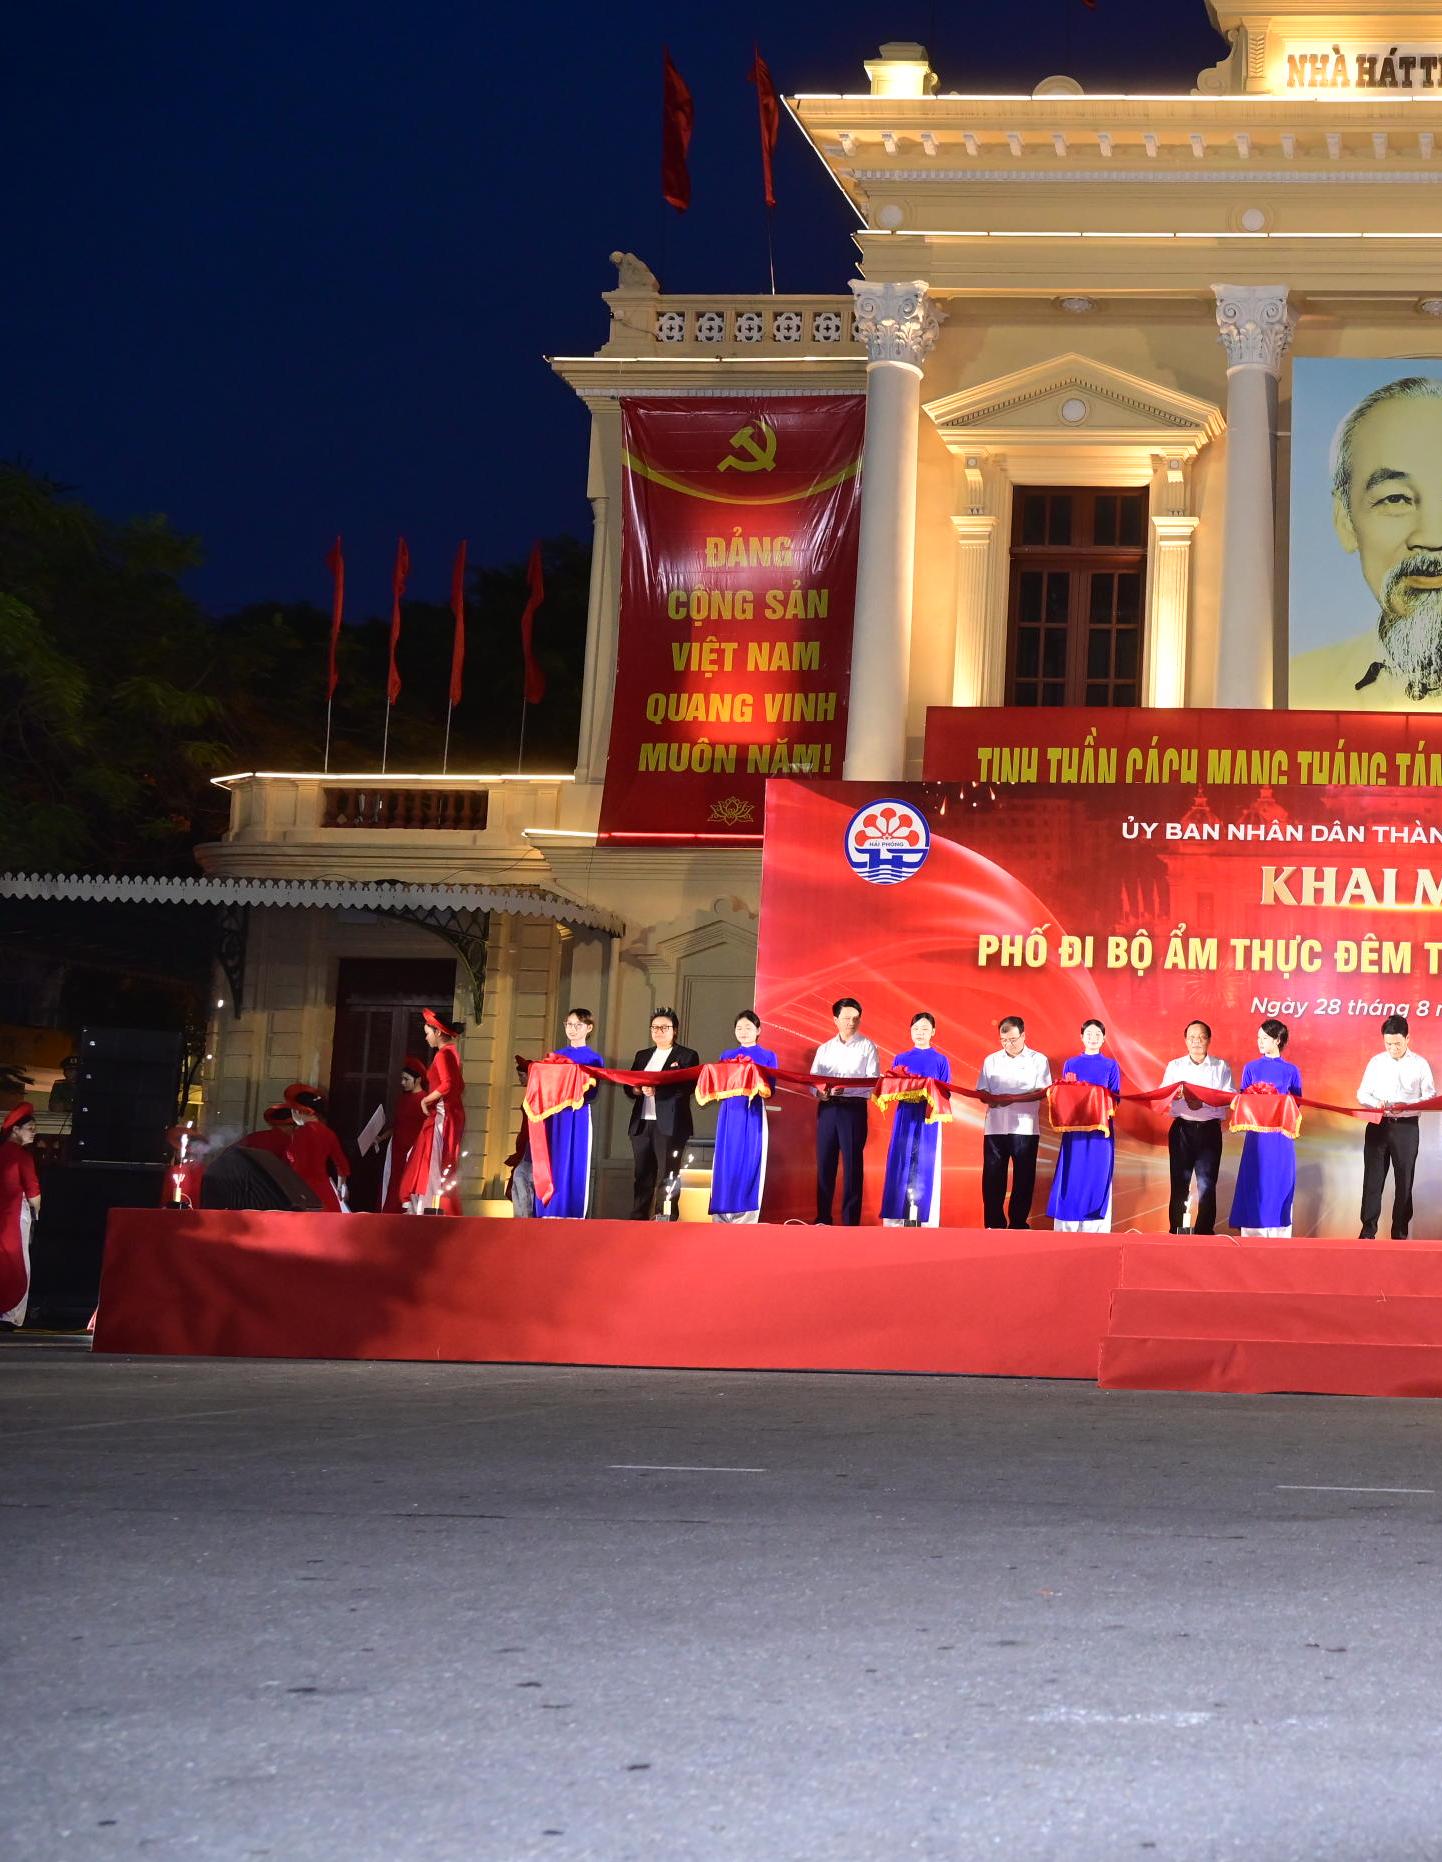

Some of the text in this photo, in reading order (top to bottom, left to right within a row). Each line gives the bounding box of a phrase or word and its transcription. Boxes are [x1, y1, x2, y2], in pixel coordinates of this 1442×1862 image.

[1287, 44, 1350, 88] NHÀ
[1356, 47, 1416, 88] HÁT
[705, 526, 794, 568] ĐẢNG
[667, 579, 829, 627] CỘNG SẢN
[671, 636, 820, 678] VIỆT NAM
[645, 692, 836, 726] QUANG VINH
[638, 737, 831, 774] MUÔN NĂM!
[977, 748, 1038, 783] TINH
[1047, 727, 1118, 784] THẦN
[1125, 736, 1198, 784] CÁCH
[1297, 739, 1387, 786] THÁNG
[1121, 816, 1159, 839] ỦY
[1165, 823, 1220, 841] BAN
[1228, 820, 1303, 842] NHÂN
[1311, 820, 1365, 843] DÂN
[1260, 866, 1399, 907] KHAI
[978, 923, 1051, 968] PHỐ
[1059, 935, 1094, 968] ĐI
[1107, 928, 1153, 977] BỘ
[1164, 923, 1218, 971] ẨM
[1230, 935, 1322, 979] THỰC
[1334, 933, 1412, 974] ĐÊM
[1250, 997, 1308, 1017] Ngày
[1314, 999, 1341, 1015] 28
[1347, 998, 1410, 1017] tháng
[1416, 1000, 1430, 1016] 8
